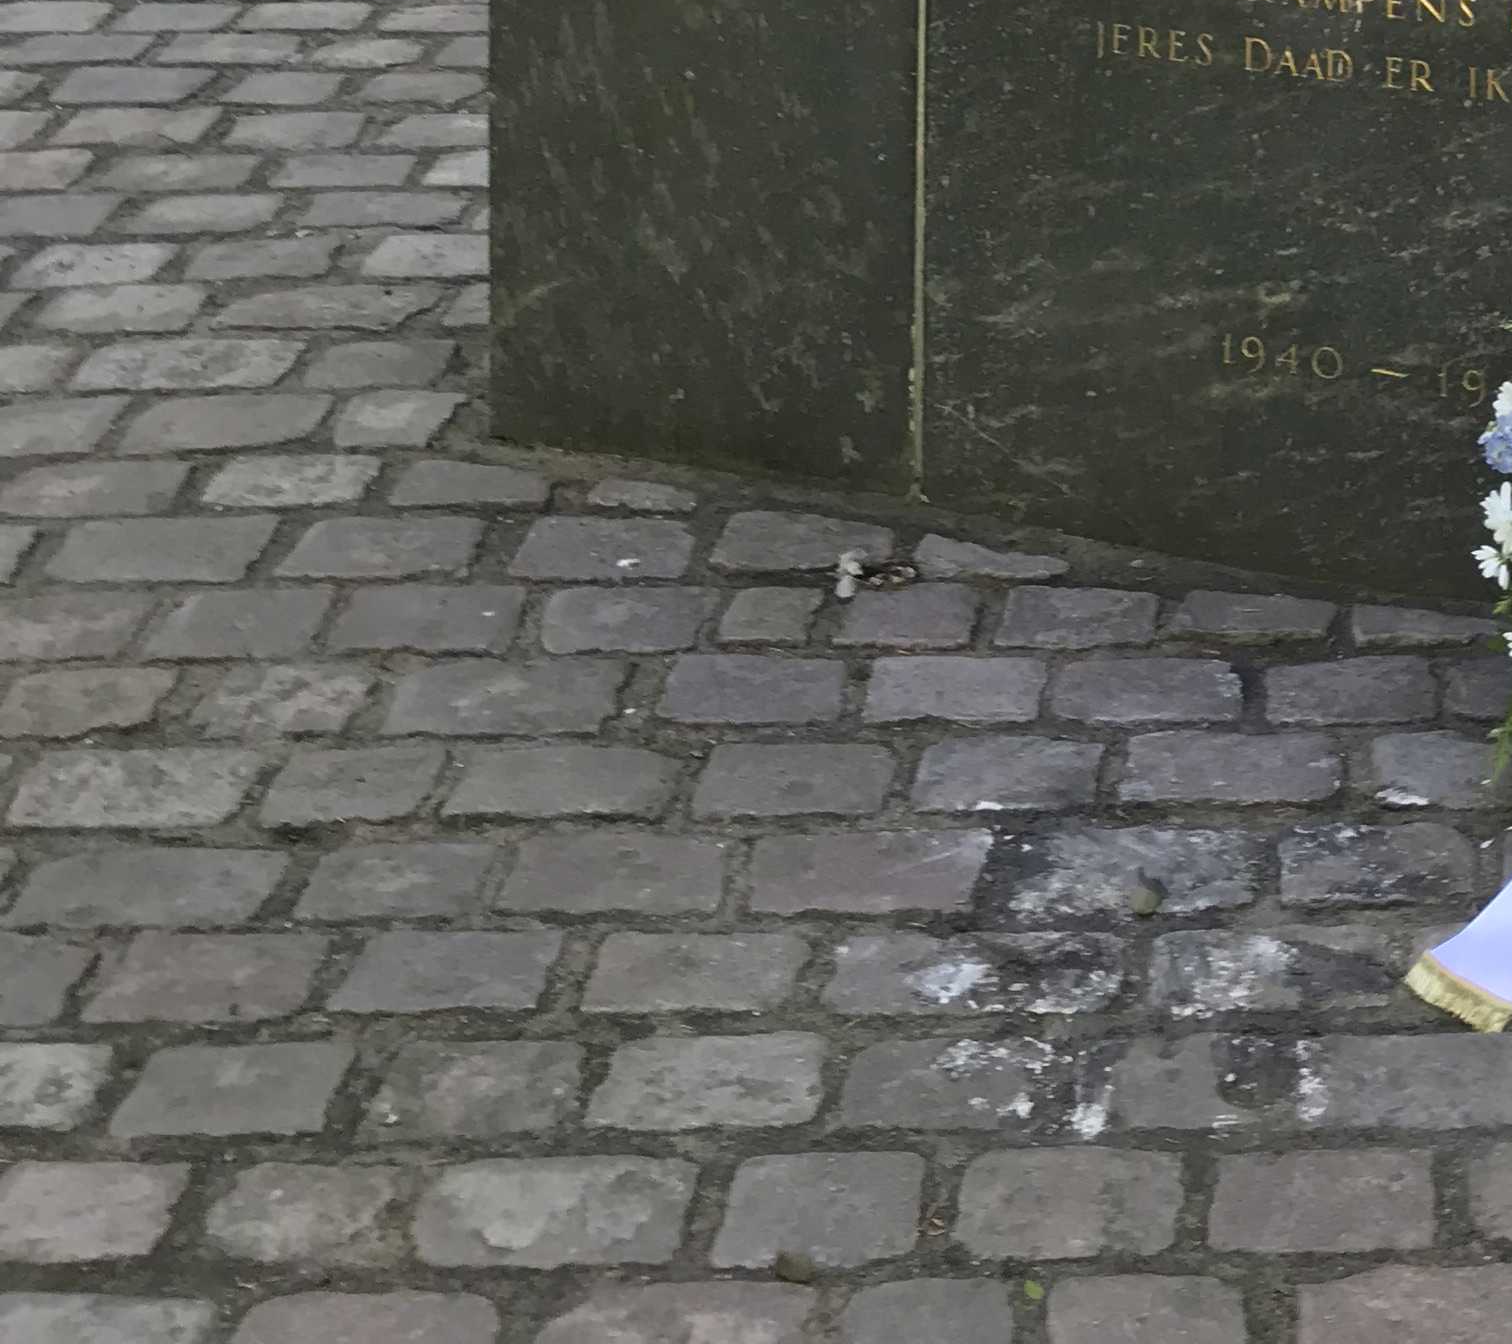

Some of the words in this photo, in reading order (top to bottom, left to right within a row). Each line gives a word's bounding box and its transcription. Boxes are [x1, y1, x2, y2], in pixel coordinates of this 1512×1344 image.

[1097, 21, 1214, 67] JERES
[1243, 36, 1355, 82] DAAD
[1382, 56, 1434, 92] ER
[1221, 332, 1344, 380] 1940
[1437, 362, 1488, 408] 19
